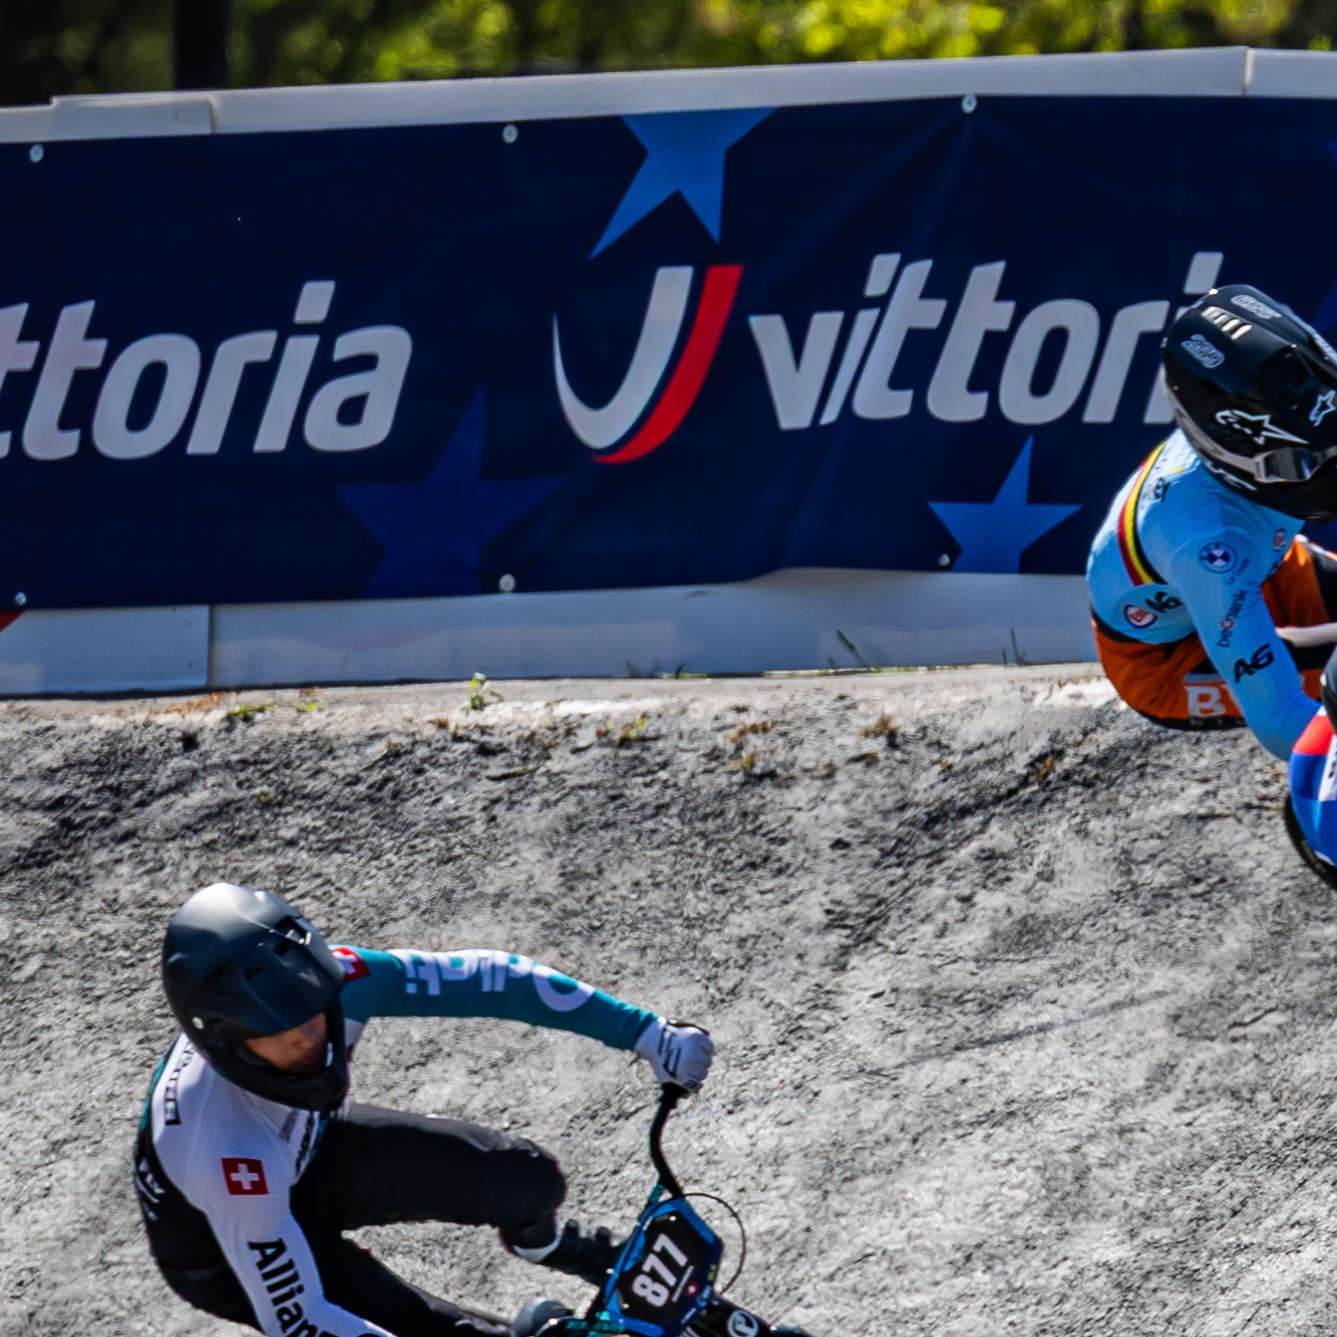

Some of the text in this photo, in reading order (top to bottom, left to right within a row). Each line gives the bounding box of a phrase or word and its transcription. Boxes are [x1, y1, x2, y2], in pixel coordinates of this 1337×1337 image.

[748, 252, 1223, 430] vittori
[1233, 642, 1276, 684] AG
[631, 1232, 689, 1308] 877
